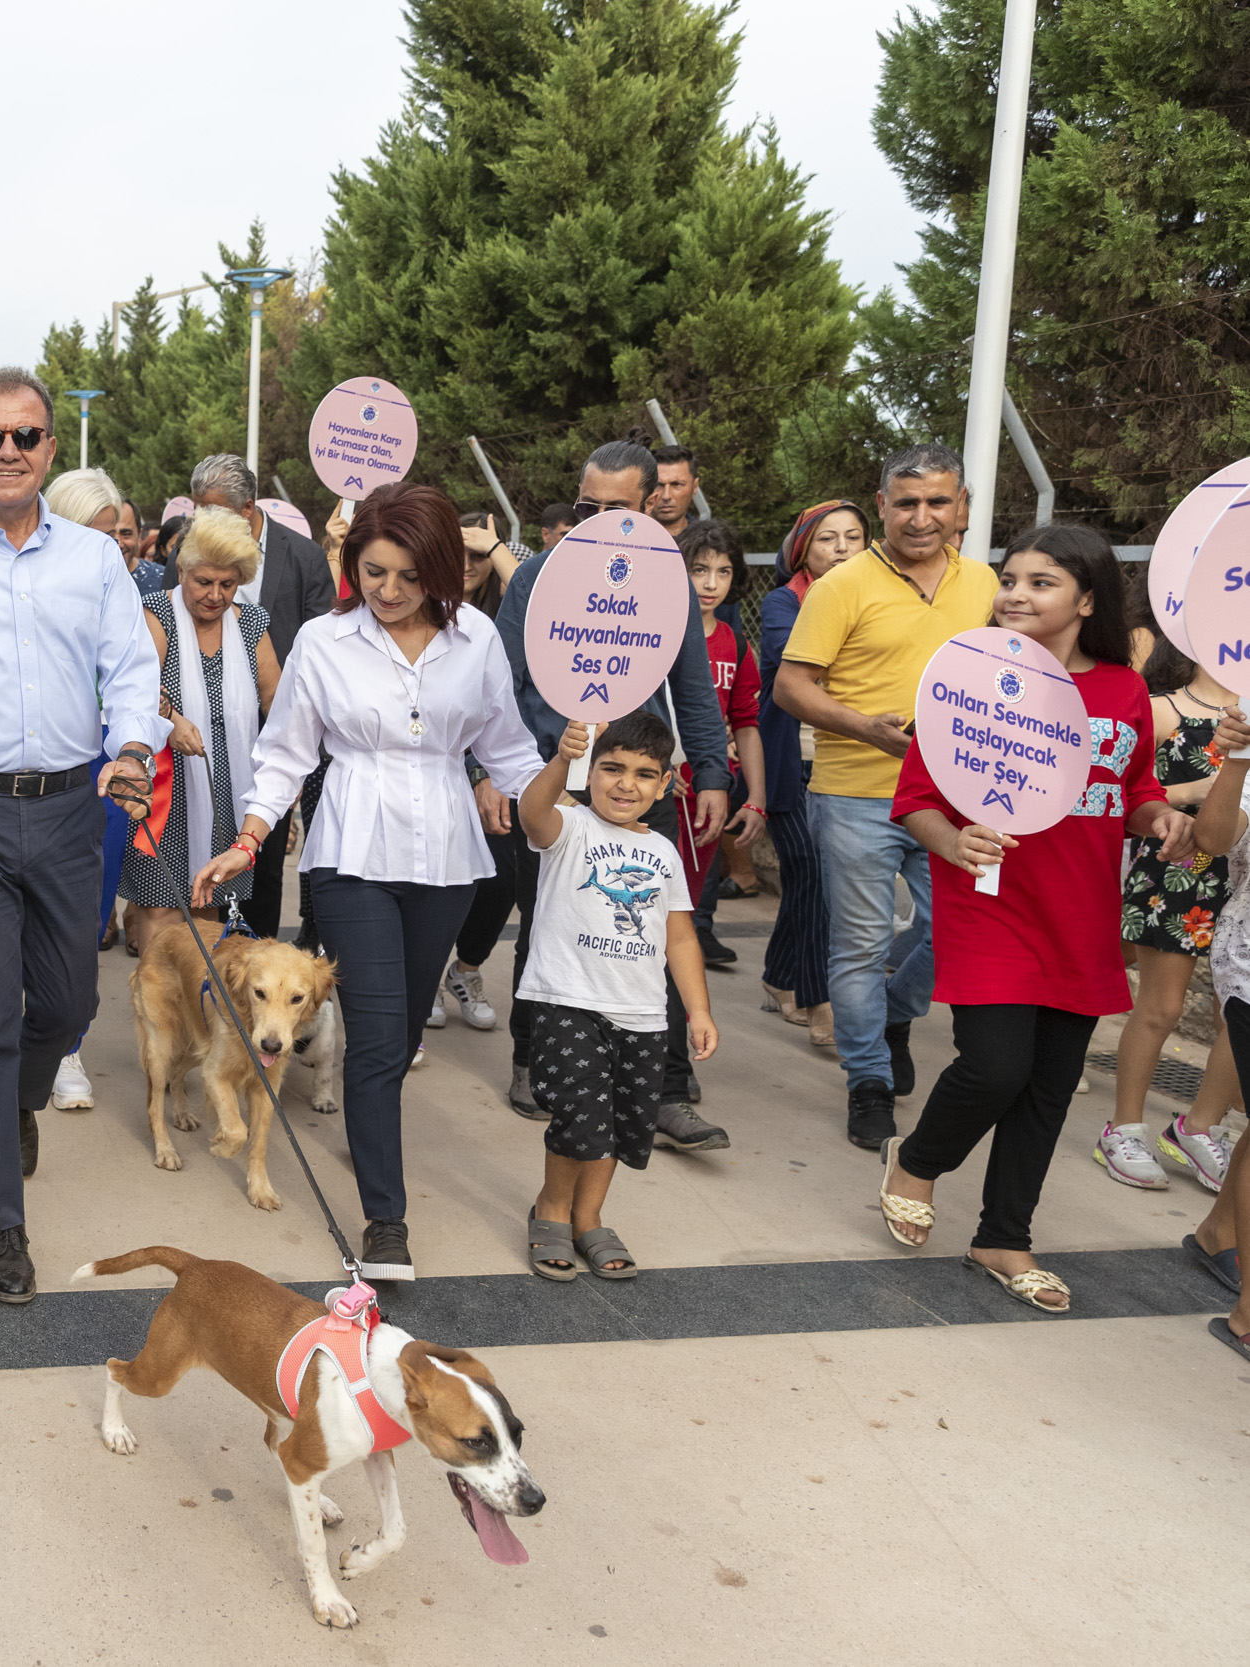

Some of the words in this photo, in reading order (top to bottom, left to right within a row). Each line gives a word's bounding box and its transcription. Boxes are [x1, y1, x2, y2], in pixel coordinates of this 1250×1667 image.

[328, 421, 378, 441] Hayvanlara
[380, 433, 402, 448] Karşı
[330, 436, 368, 452] Acımasız
[370, 445, 393, 459] Olan,
[315, 444, 326, 458] İyi
[327, 448, 340, 459] Bir
[342, 450, 365, 465] İnsan
[367, 458, 402, 473] Olamaz.
[586, 592, 638, 616] Sokak
[549, 621, 662, 648] Hayvanlarına
[571, 653, 601, 674] Ses
[606, 655, 630, 676] Ol!
[932, 682, 988, 716] Onları
[993, 702, 1082, 747] Sevmekle
[952, 717, 1057, 769] Başlayacak
[954, 747, 990, 774] Her
[994, 761, 1047, 794] Şey...
[584, 842, 626, 865] SHARK
[631, 847, 672, 879] ATTACK
[577, 933, 622, 953] PACIFIC
[626, 941, 657, 957] OCEAN
[599, 951, 639, 962] ADVENTURE
